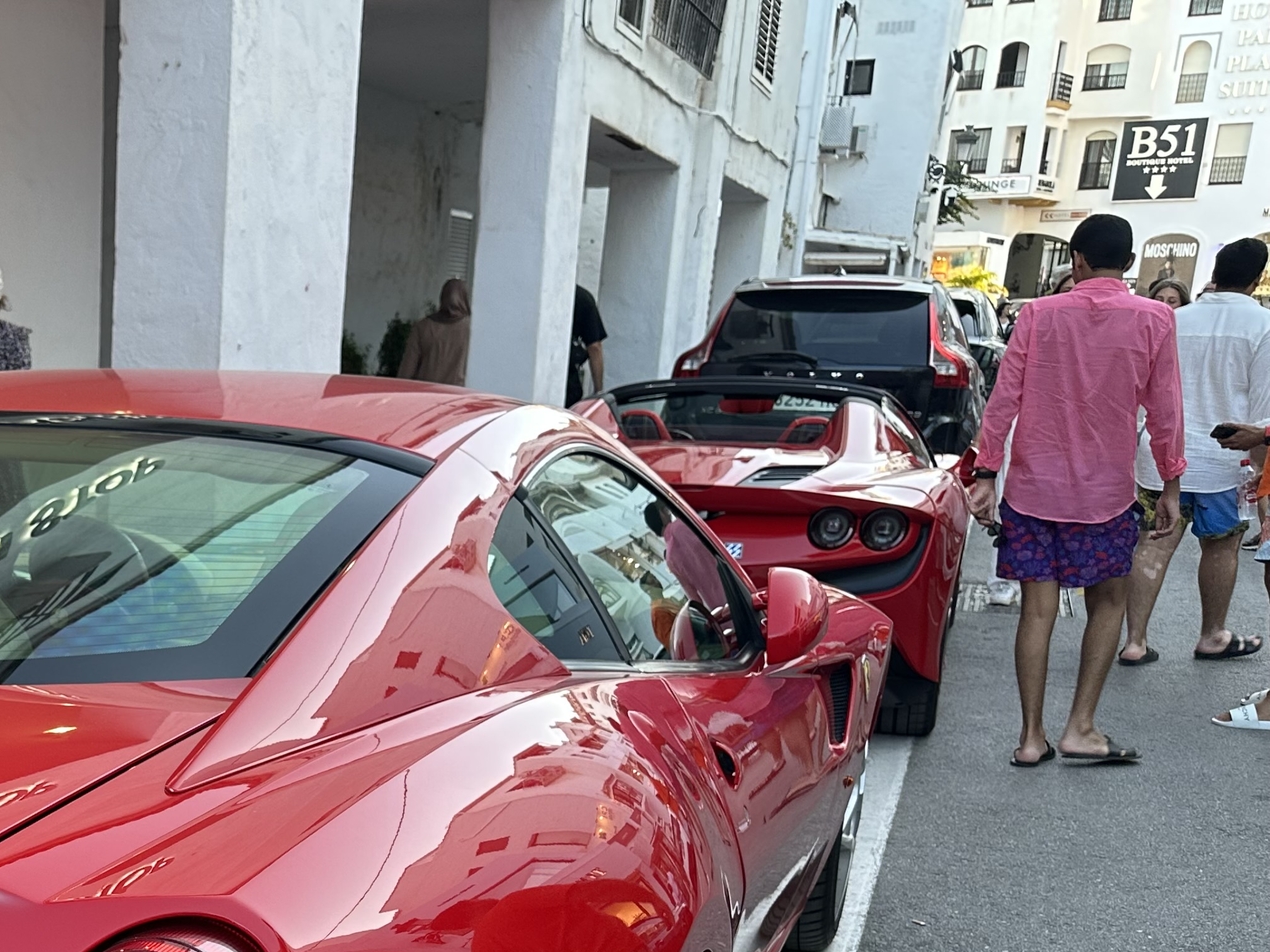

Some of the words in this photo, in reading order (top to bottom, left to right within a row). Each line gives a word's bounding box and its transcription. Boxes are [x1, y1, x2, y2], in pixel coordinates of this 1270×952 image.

[1126, 122, 1197, 159] B51
[1126, 158, 1166, 167] BOUTIQUE
[1167, 156, 1194, 165] HOTEL
[1143, 242, 1198, 259] MOSCHINO
